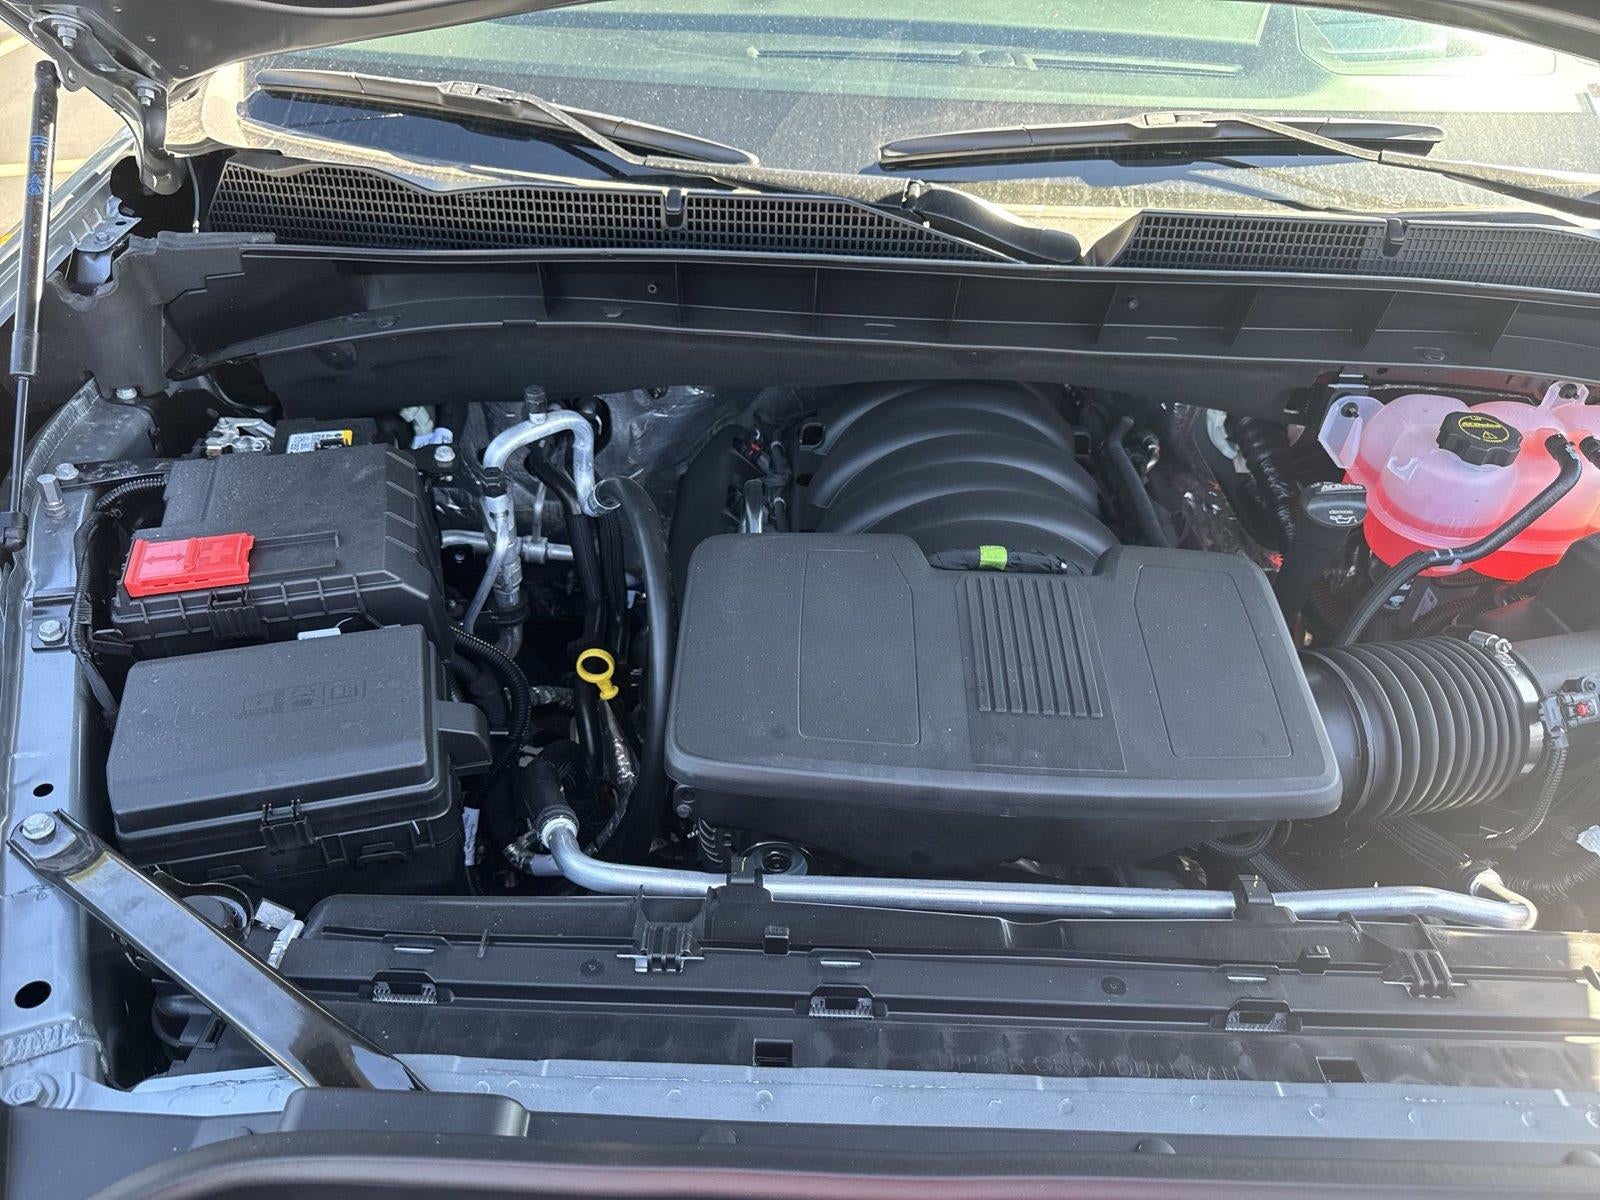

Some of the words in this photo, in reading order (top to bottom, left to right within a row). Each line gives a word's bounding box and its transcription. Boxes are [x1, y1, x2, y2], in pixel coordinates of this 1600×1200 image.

[1461, 421, 1502, 429] ACDelco
[1321, 483, 1364, 492] ACDelco
[938, 1053, 1027, 1072] UPPER
